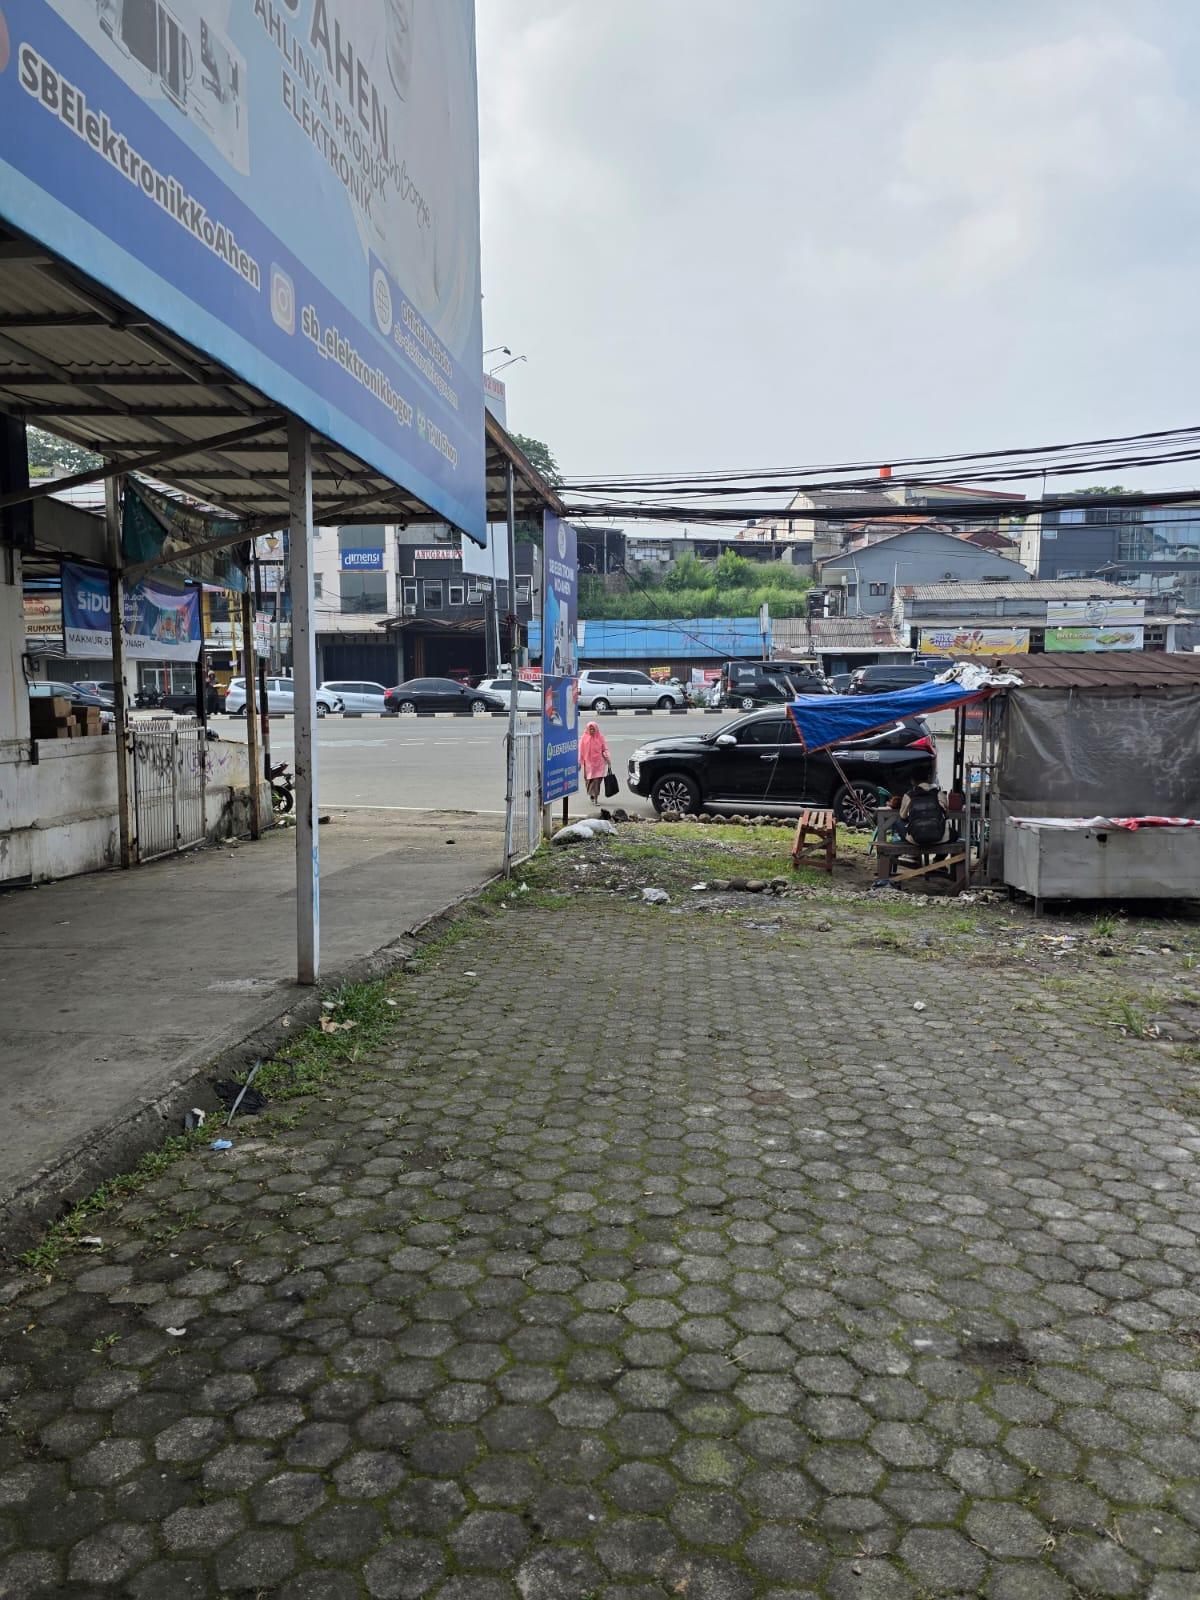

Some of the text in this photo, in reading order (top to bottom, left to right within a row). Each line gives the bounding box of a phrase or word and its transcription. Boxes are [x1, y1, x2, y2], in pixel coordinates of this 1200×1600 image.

[254, 0, 387, 201] AHLINYA PRODUK
[282, 69, 371, 219] ELEKTRONIK
[311, 0, 388, 160] AHEN
[19, 45, 260, 290] SBElektronikKoAhen
[301, 304, 414, 428] sb_elektronikbogor
[77, 591, 111, 614] SiDU
[344, 552, 380, 565] dimensi
[415, 550, 451, 559] ANUGRAH
